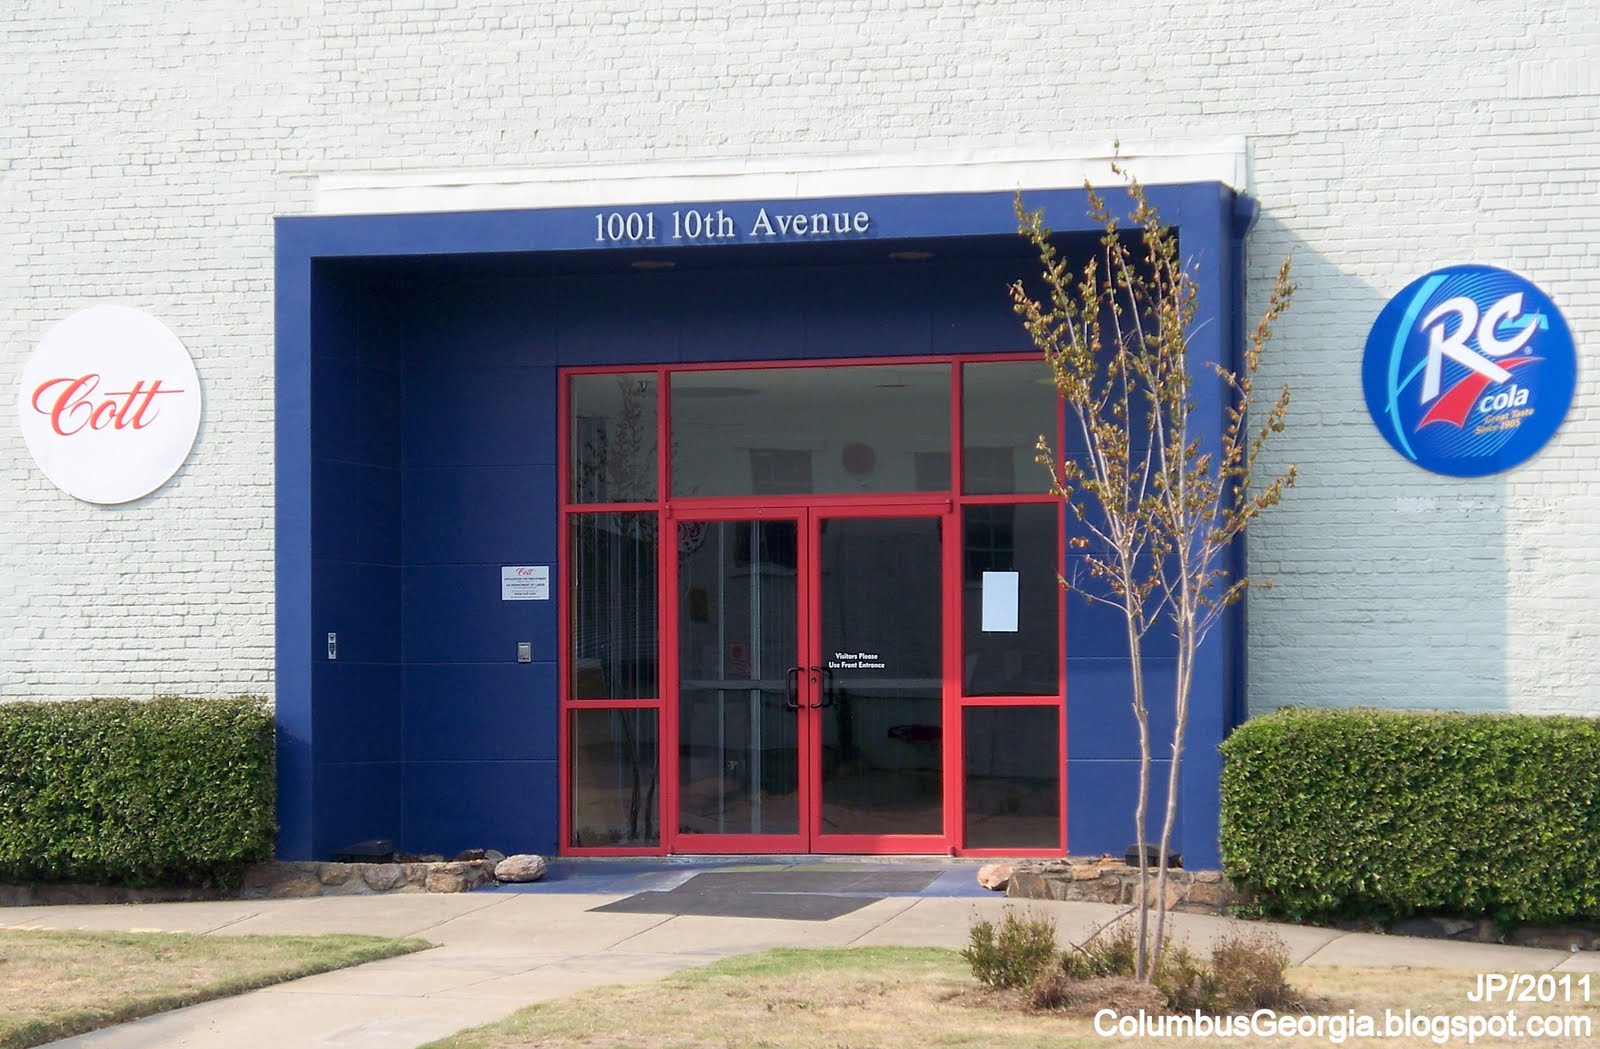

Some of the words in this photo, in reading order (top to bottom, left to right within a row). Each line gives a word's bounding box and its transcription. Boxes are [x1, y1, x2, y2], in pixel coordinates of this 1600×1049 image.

[595, 211, 656, 242] 1001
[672, 209, 736, 240] 10th
[749, 207, 870, 237] Avenue
[1421, 292, 1539, 405] RC
[32, 373, 185, 436] Cott
[1479, 384, 1530, 413] cola
[1484, 412, 1509, 424] Great
[1509, 408, 1535, 420] Taste
[1474, 424, 1500, 435] Since
[1500, 418, 1521, 430] 1905
[516, 568, 535, 576] Cott
[835, 652, 858, 660] Visitors
[858, 652, 878, 660] Please
[828, 661, 840, 669] Use
[841, 661, 857, 669] Front
[858, 661, 885, 669] Entrance
